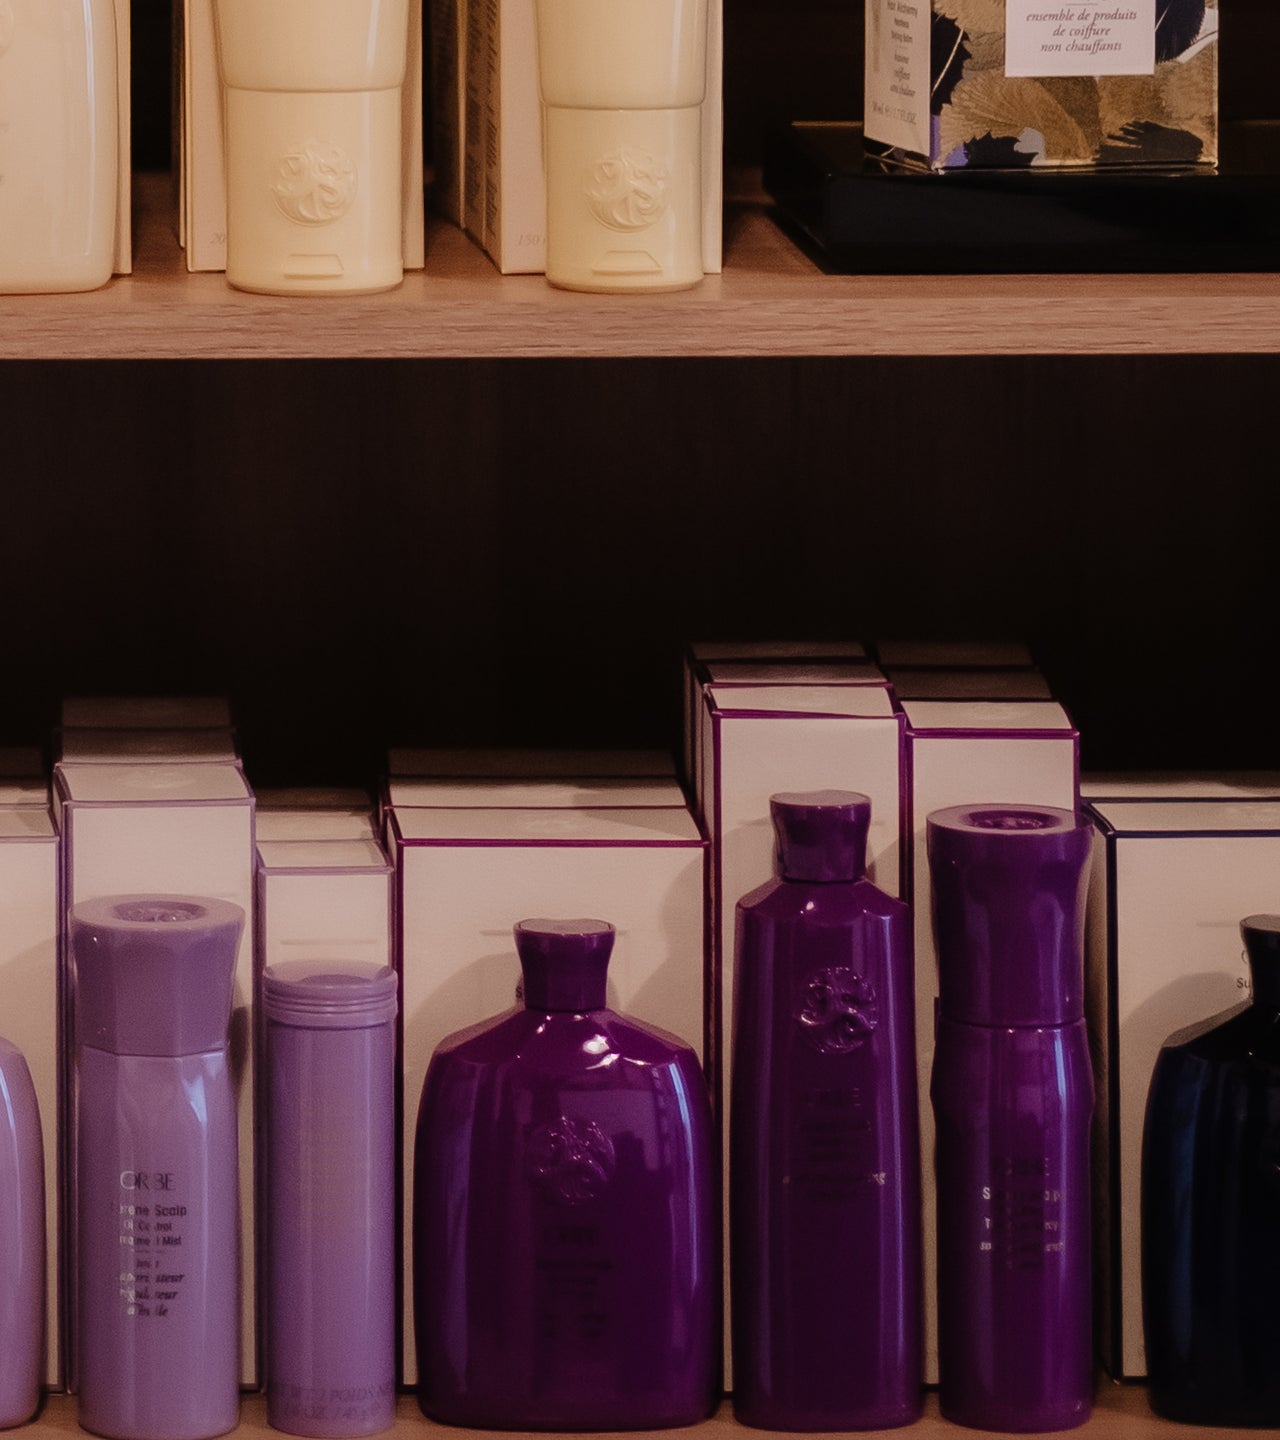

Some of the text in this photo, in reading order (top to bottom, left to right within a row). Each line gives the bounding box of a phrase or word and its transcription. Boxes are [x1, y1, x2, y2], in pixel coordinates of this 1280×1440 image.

[1026, 8, 1138, 27] ensemble de produits
[1052, 23, 1111, 41] de coiffure
[1040, 39, 1122, 56] non chauffants
